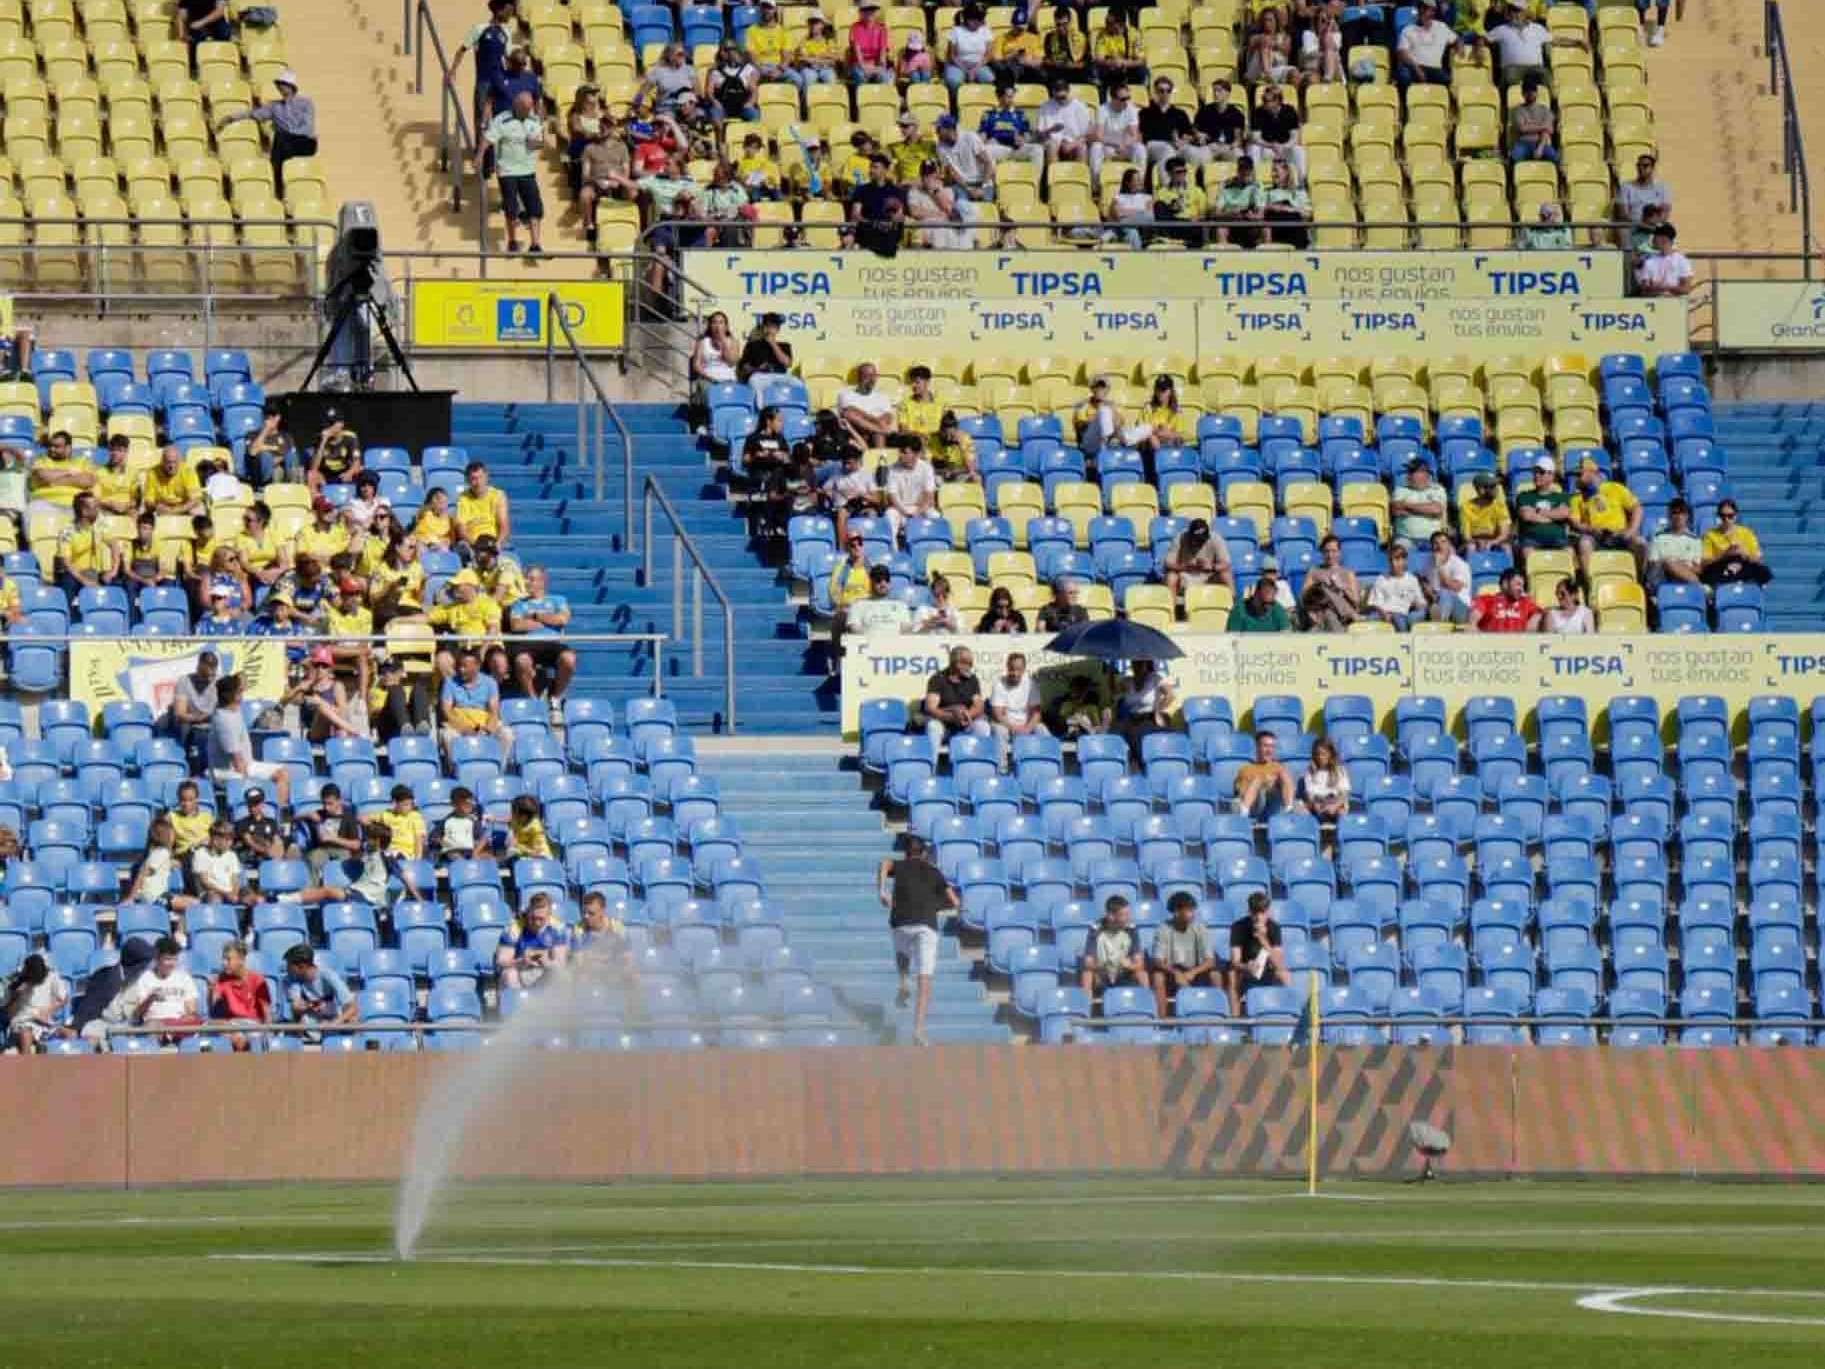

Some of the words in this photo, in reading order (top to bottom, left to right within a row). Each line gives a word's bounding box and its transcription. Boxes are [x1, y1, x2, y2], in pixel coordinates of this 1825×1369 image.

[738, 271, 830, 295] TIPSA
[858, 267, 896, 283] nos
[903, 265, 977, 286] gustan
[1010, 272, 1102, 295] TIPSA
[1216, 272, 1307, 295] TIPSA
[1335, 267, 1374, 283] nos
[1379, 265, 1455, 287] gustan
[1487, 271, 1580, 295] TIPSA
[979, 312, 1045, 329] TIPSA
[1093, 312, 1158, 330] TIPSA
[1235, 312, 1302, 330] TIPSA
[1351, 312, 1417, 329] TIPSA
[1580, 312, 1646, 330] TIPSA
[869, 656, 939, 675] TIPSA
[1327, 657, 1400, 676] TIPSA
[1550, 655, 1623, 675] TIPSA
